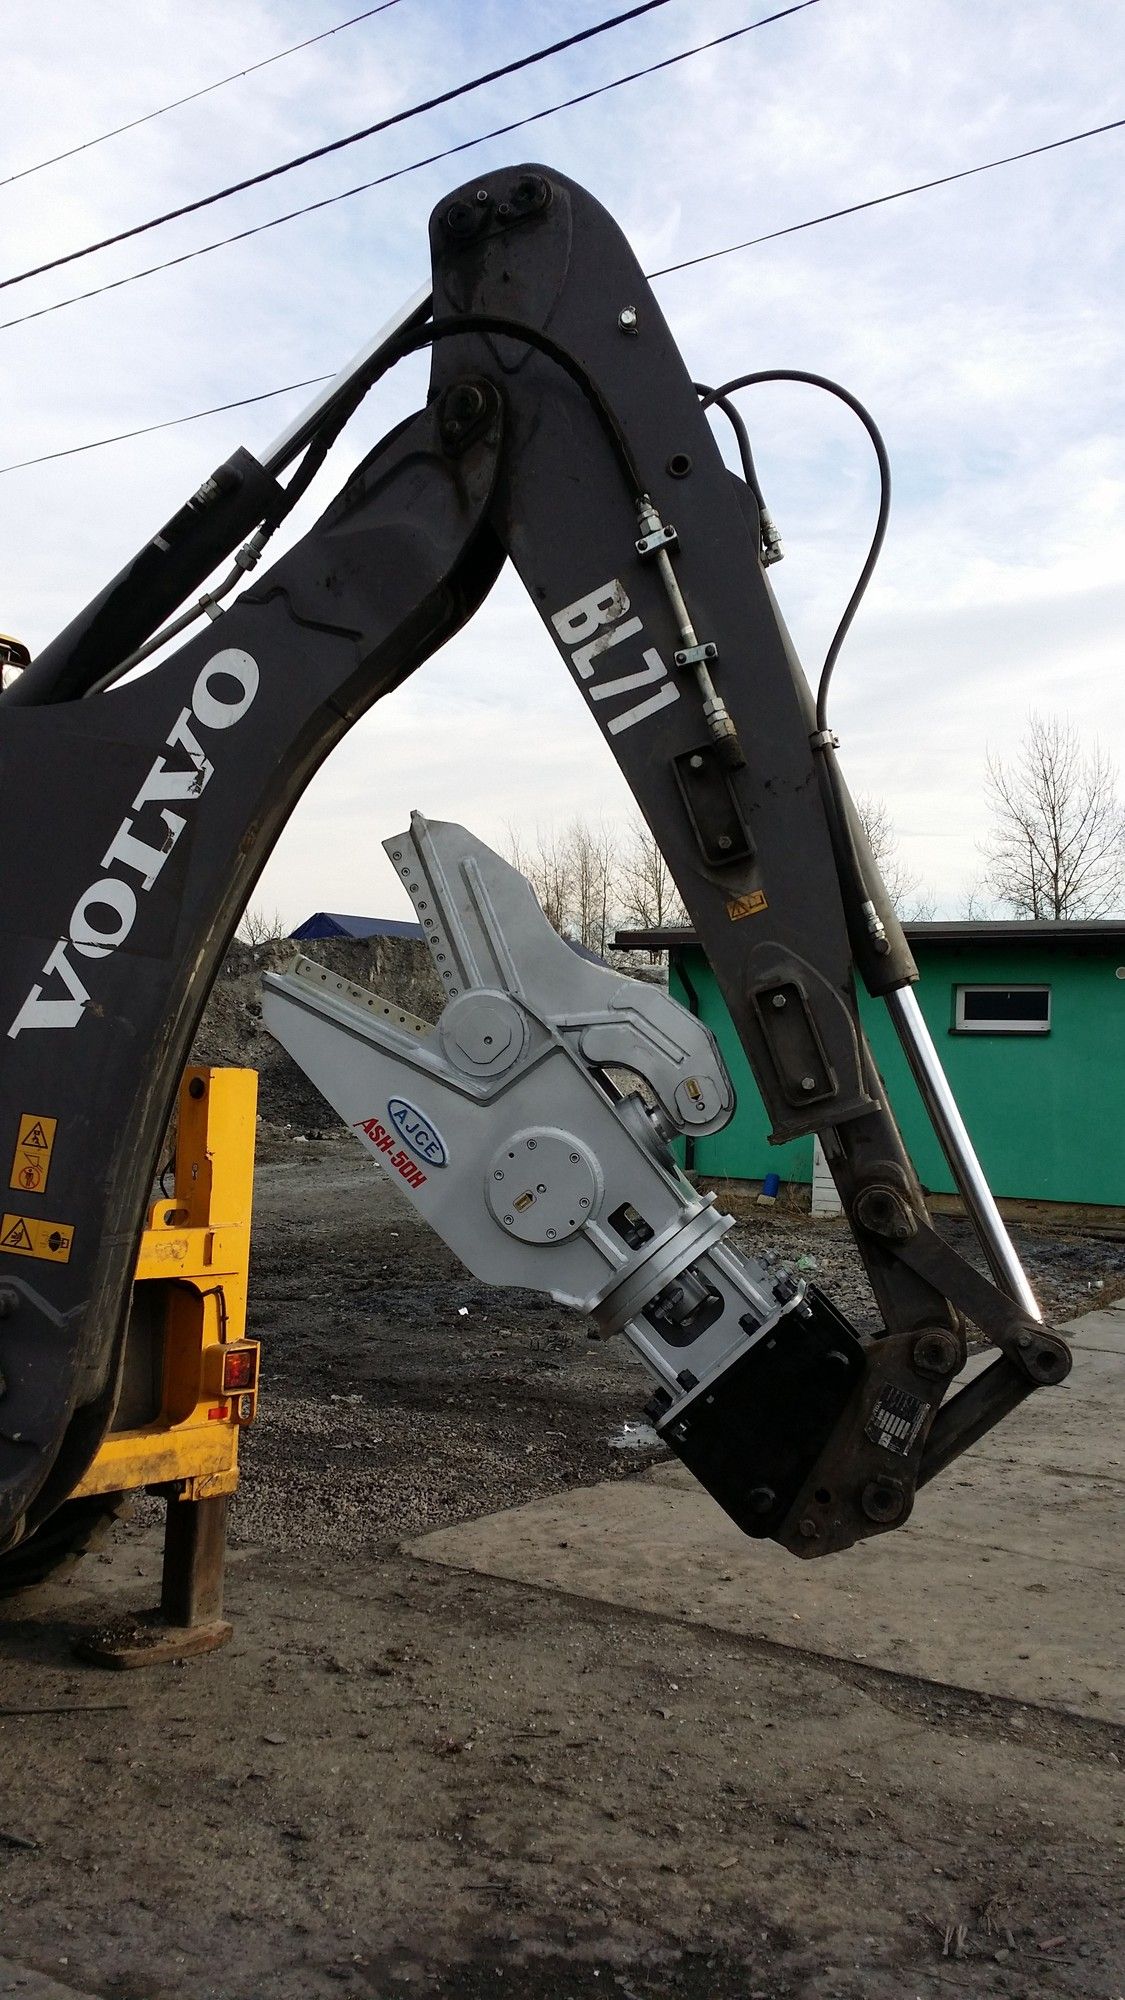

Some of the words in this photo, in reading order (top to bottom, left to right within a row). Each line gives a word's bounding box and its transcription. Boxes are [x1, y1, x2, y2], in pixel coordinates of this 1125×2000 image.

[551, 578, 681, 736] BL71
[7, 647, 261, 1039] VOLVO
[352, 1117, 428, 1189] ASH-50H
[392, 1108, 440, 1158] AJCE
